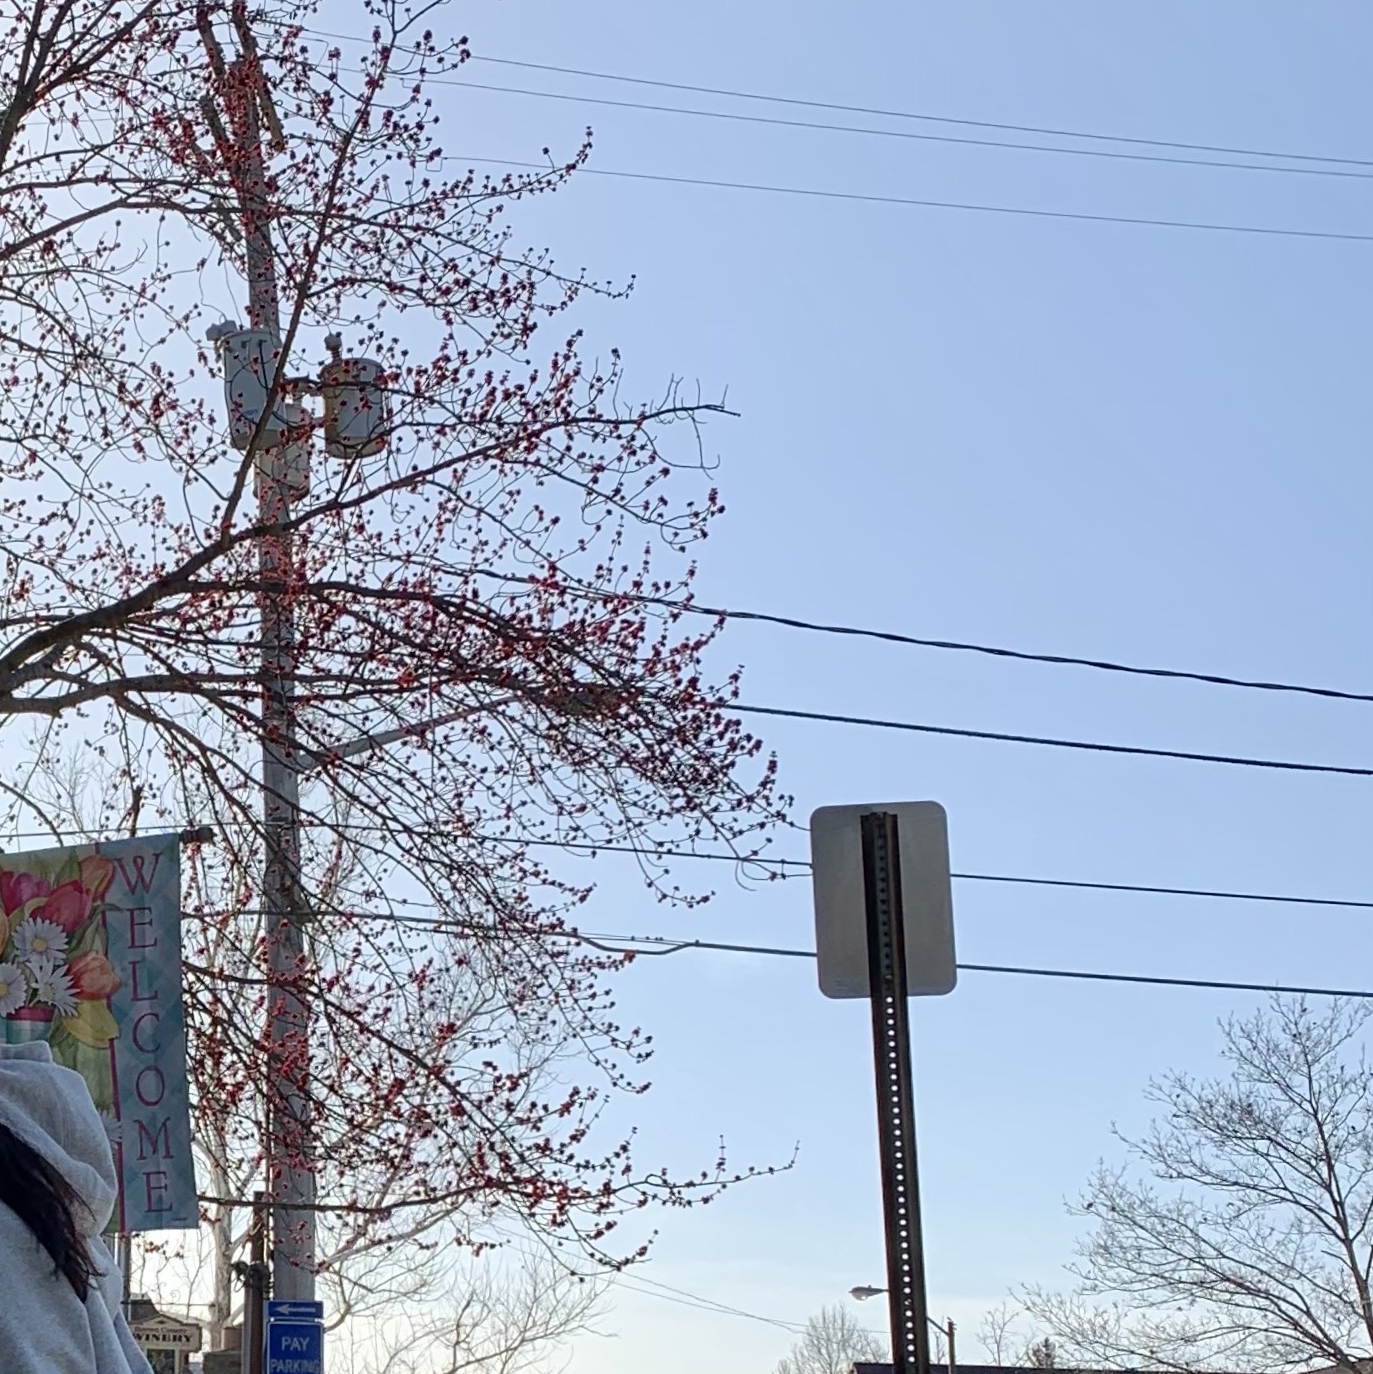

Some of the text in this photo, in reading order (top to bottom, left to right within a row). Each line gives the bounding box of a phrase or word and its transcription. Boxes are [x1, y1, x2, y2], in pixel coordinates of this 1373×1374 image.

[113, 852, 175, 1213] WELCOME
[132, 1333, 193, 1342] WINERY
[281, 1337, 310, 1351] PAY
[270, 1359, 320, 1374] PARKING
